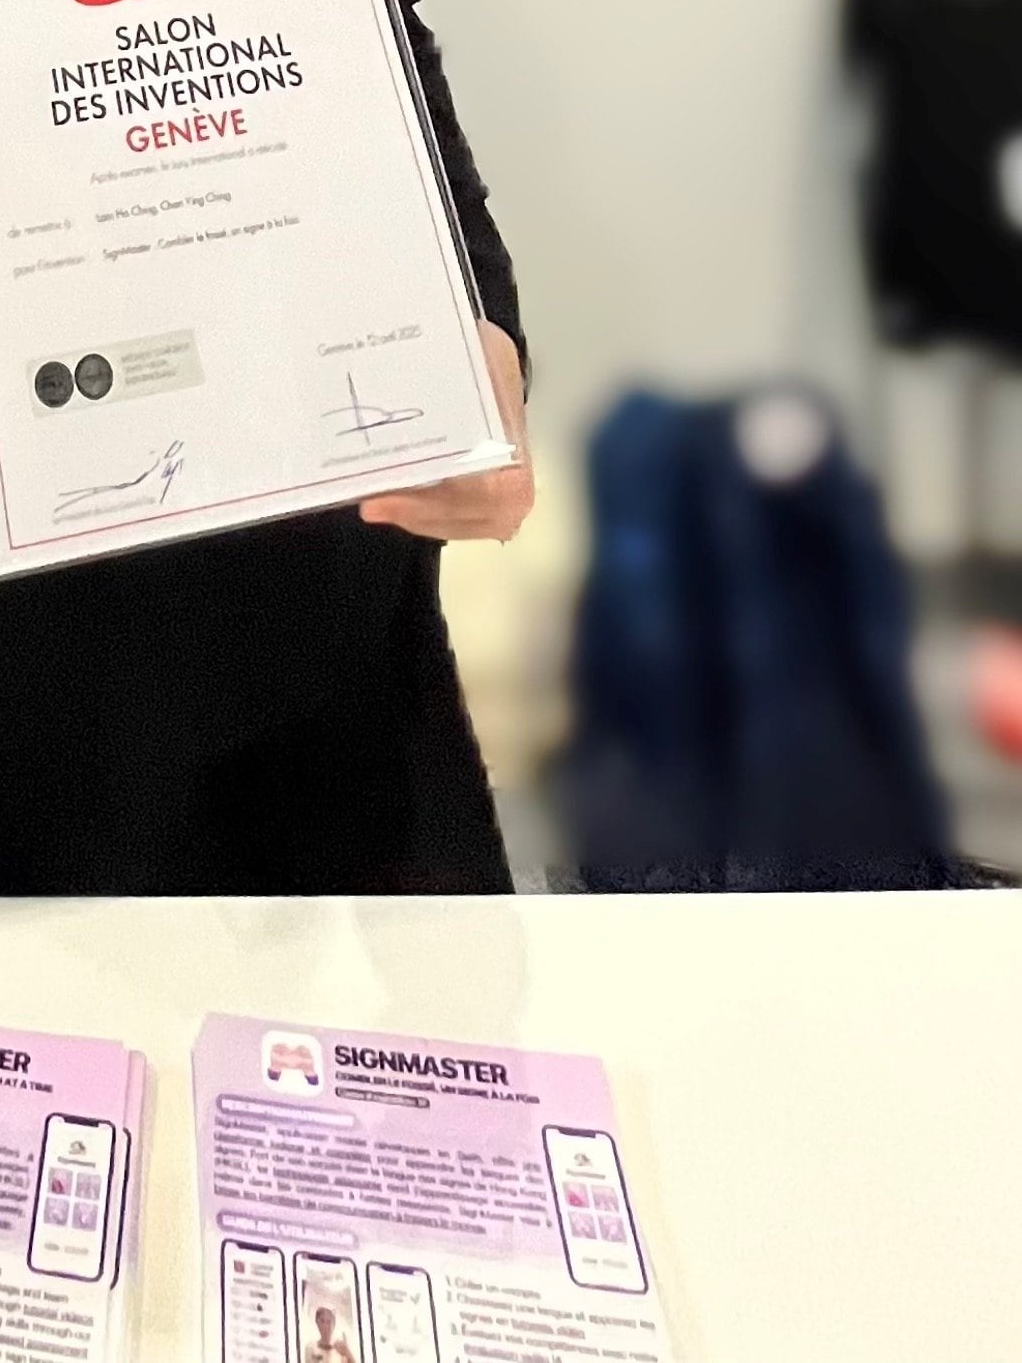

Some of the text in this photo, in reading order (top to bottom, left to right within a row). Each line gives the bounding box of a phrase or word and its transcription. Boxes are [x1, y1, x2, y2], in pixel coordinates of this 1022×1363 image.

[115, 13, 216, 51] SALON
[51, 33, 292, 94] INTERNATIONAL
[51, 62, 303, 126] DES INVENTIONS
[125, 107, 248, 152] GENÈVE
[334, 1044, 509, 1087] SIGNMASTER
